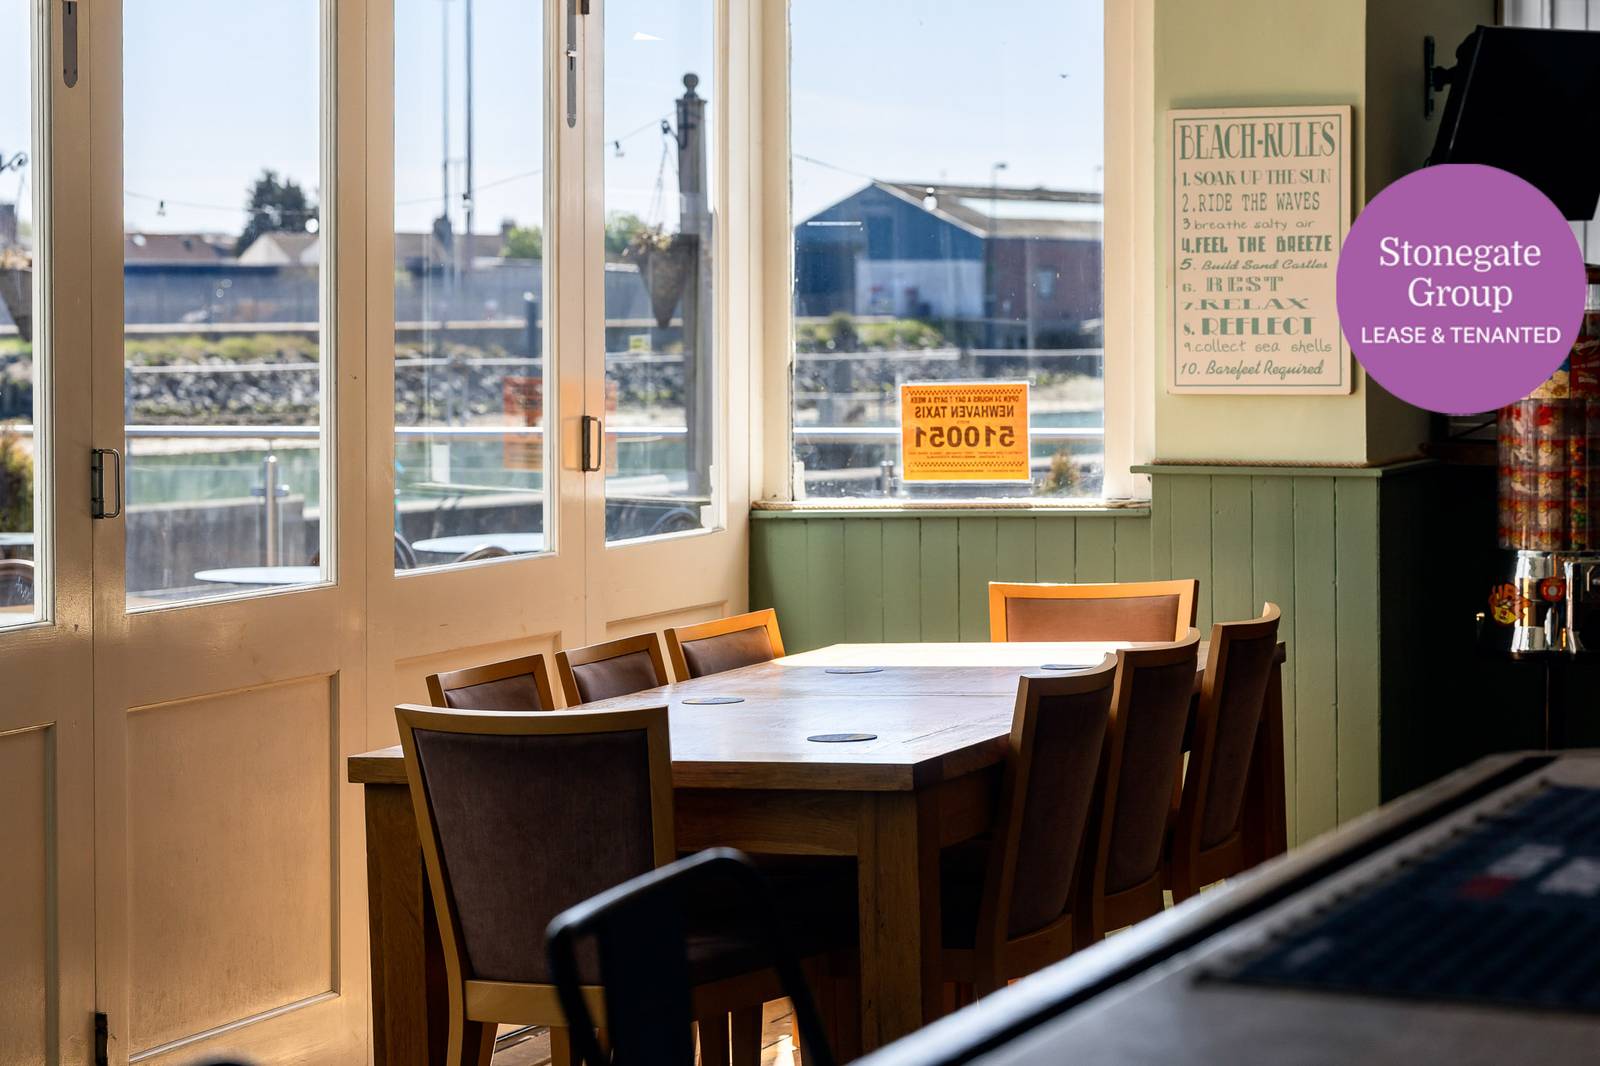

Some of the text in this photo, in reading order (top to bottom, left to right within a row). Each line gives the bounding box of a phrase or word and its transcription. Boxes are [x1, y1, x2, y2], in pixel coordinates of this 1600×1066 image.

[1194, 170, 1236, 185] SOAK
[1240, 170, 1262, 185] UP
[1266, 169, 1295, 184] THE
[1299, 168, 1331, 184] SUN
[1241, 192, 1267, 212] THE
[1276, 191, 1320, 211] WAVES
[1195, 219, 1248, 230] breathe
[1254, 218, 1287, 231] salty
[1295, 219, 1315, 229] air
[1238, 235, 1266, 253] THE
[1276, 235, 1332, 252] BREEZE
[1201, 260, 1240, 270] Build
[1242, 259, 1280, 270] Sand
[1282, 258, 1328, 270] Castles
[1206, 276, 1284, 292] REST
[1201, 317, 1317, 335] REFLECT
[1255, 342, 1280, 352] sea
[1291, 337, 1332, 353] shells
[1180, 363, 1201, 375] 10.
[1263, 359, 1325, 380] Required
